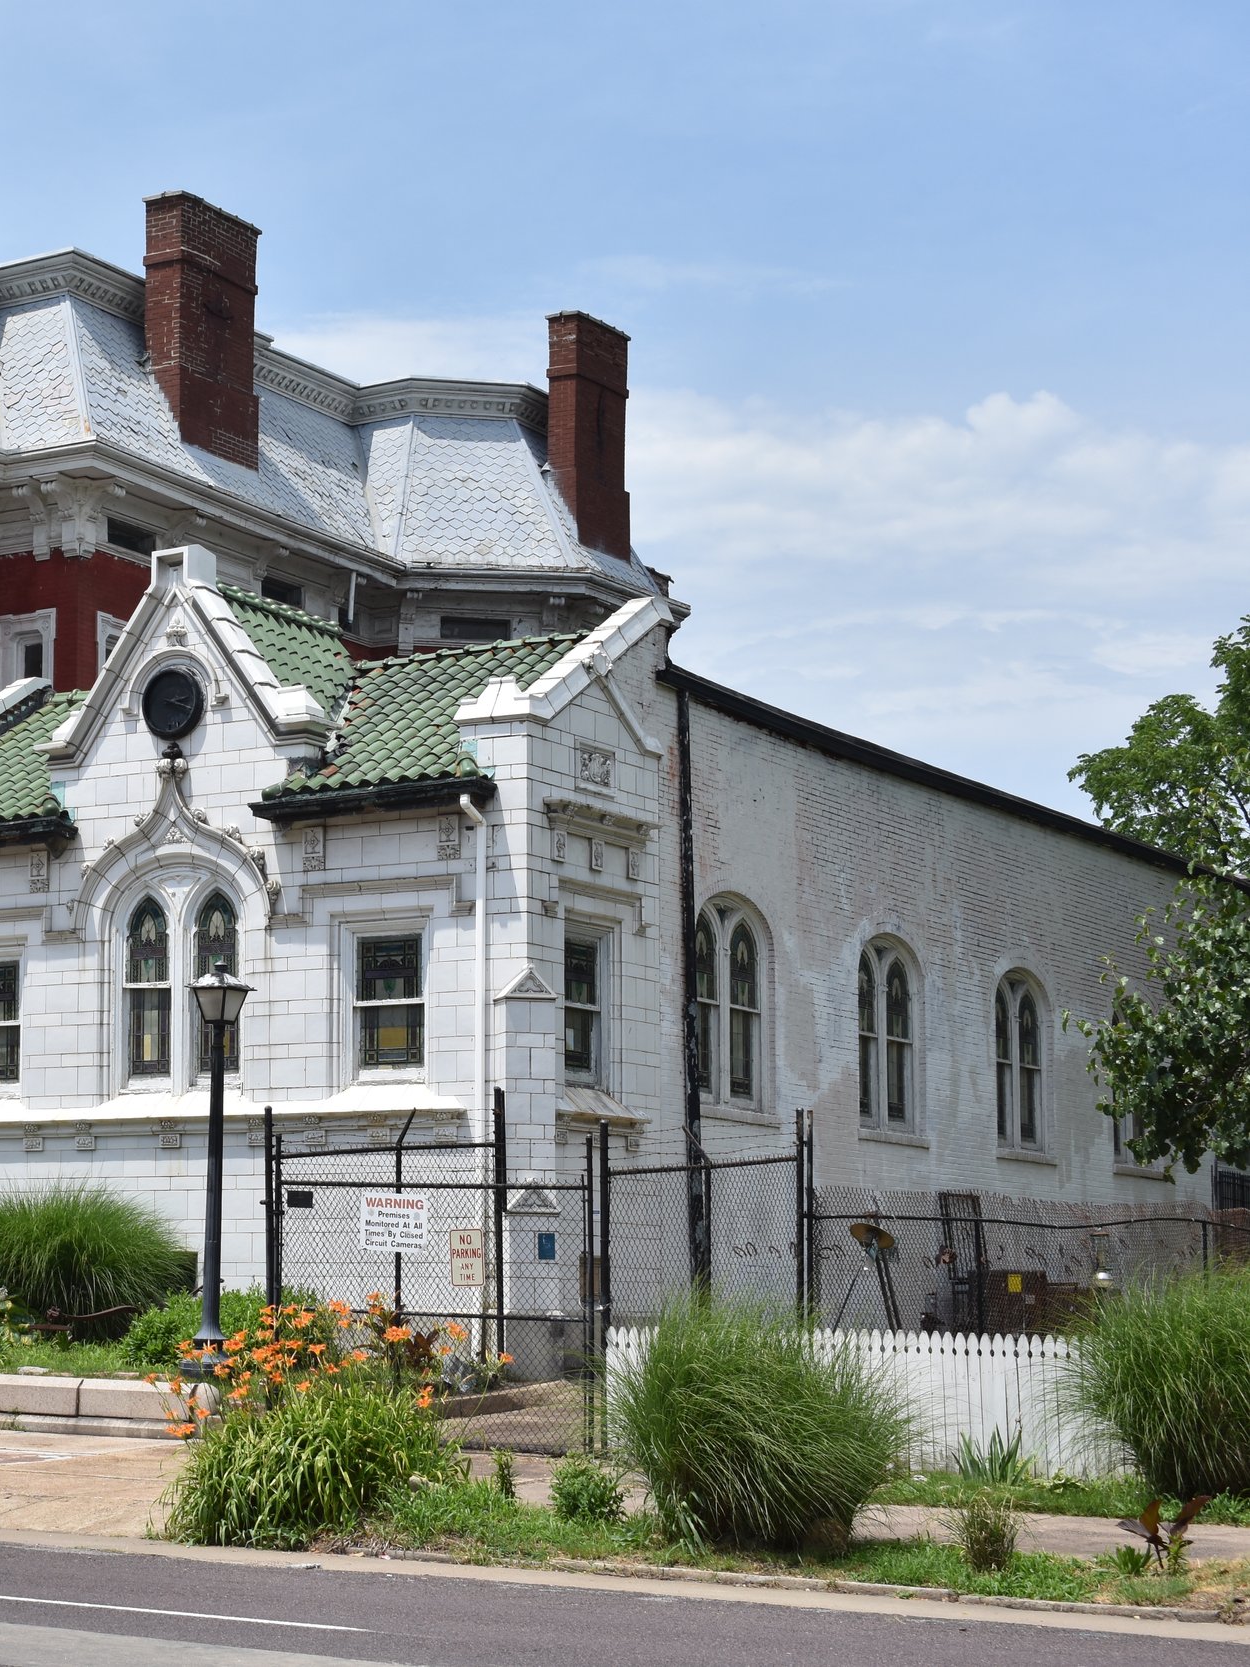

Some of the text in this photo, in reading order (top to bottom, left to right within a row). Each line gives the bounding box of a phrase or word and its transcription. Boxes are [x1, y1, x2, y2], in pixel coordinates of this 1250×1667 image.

[365, 1197, 424, 1210] WARNING
[378, 1210, 410, 1219] Premises
[365, 1219, 423, 1230] Monitored At All
[365, 1229, 424, 1239] Times By Closed
[459, 1234, 472, 1245] NO
[365, 1238, 422, 1249] Circuit Cameras
[452, 1248, 482, 1259] PARKING
[461, 1263, 474, 1271] ANY
[460, 1273, 476, 1281] TIME
